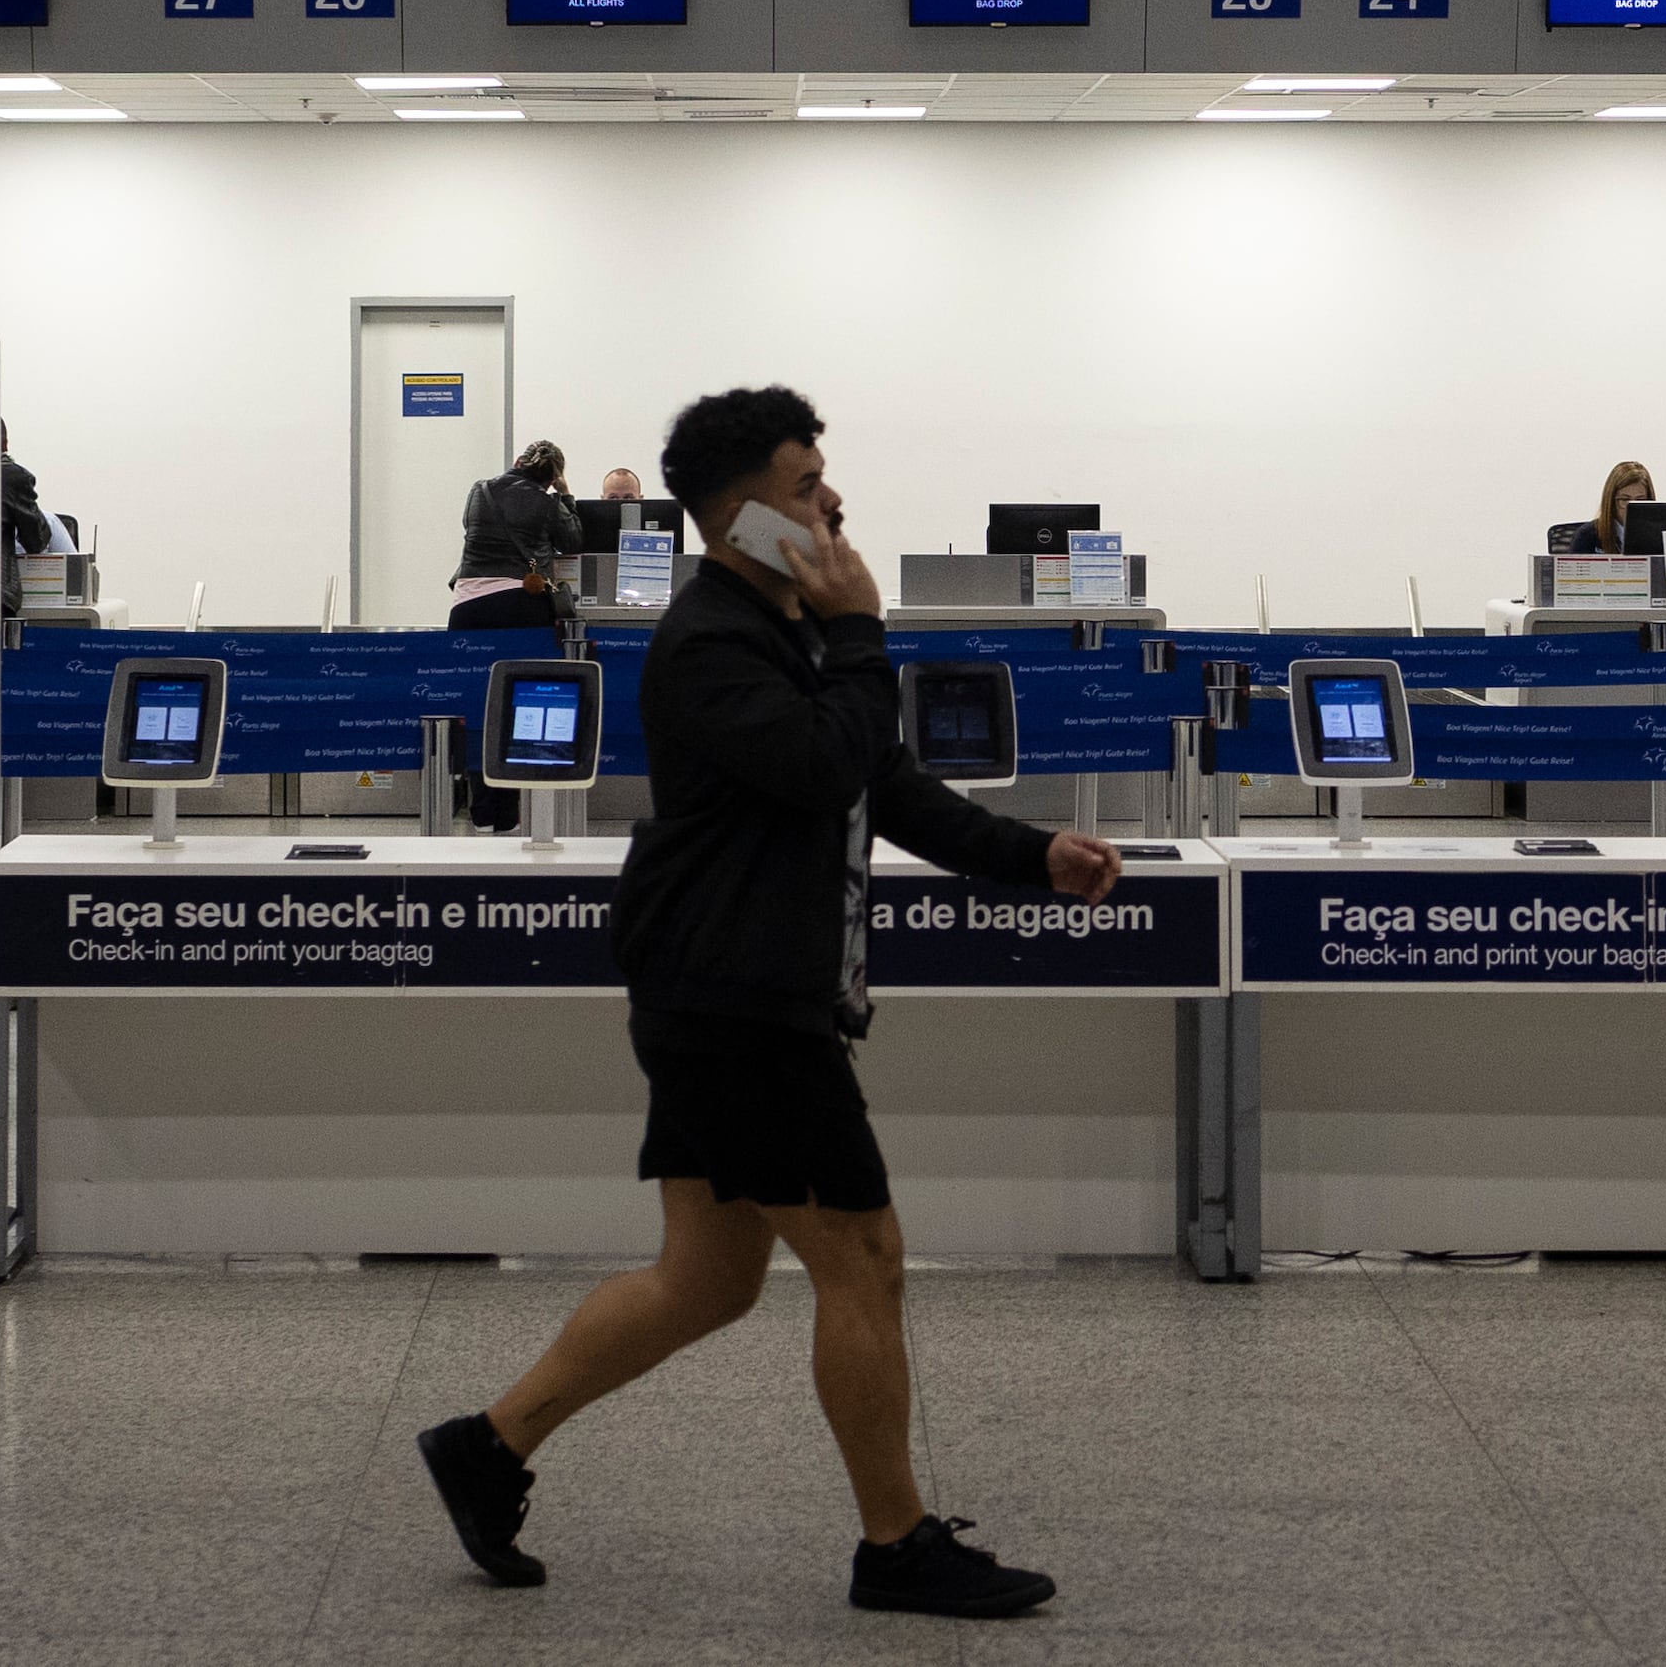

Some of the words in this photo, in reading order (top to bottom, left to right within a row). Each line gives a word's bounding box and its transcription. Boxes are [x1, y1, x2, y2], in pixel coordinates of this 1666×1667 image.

[976, 0, 995, 9] BAG
[996, 0, 1024, 9] DROP
[1320, 897, 1416, 941] Faça
[1426, 905, 1498, 932] seu
[1321, 942, 1428, 966] Check-in
[1433, 942, 1479, 966] and
[1485, 942, 1539, 971] print
[1543, 947, 1598, 971] your
